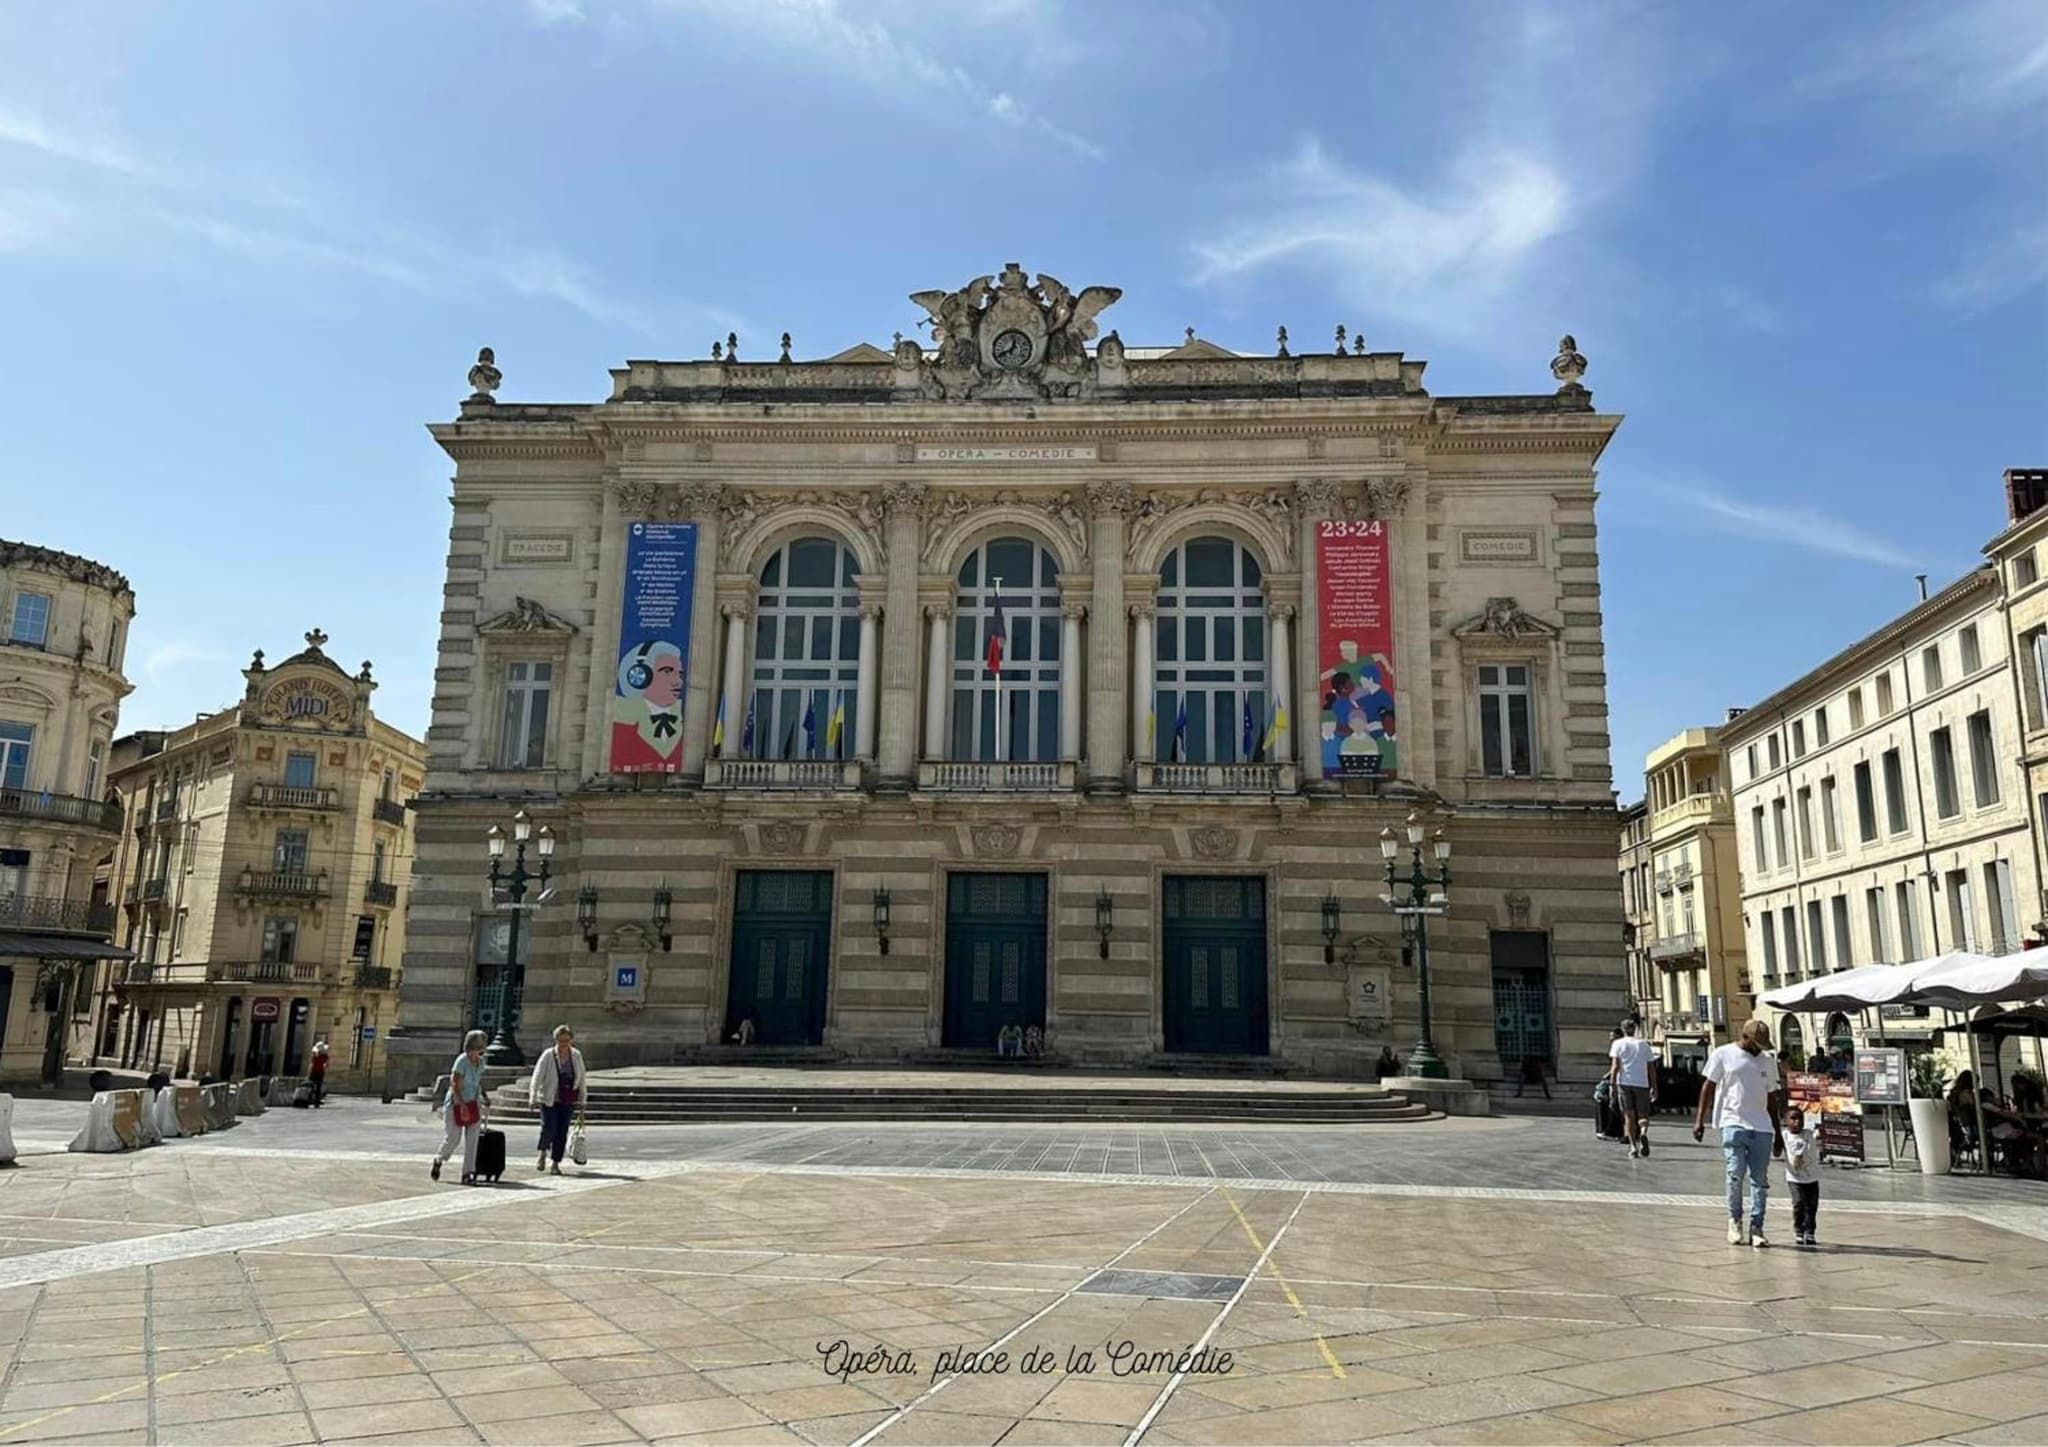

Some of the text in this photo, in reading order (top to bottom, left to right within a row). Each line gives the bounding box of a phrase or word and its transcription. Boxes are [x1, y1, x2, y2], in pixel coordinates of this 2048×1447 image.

[269, 679, 308, 705] GRAND
[286, 696, 329, 716] MIDI
[621, 973, 633, 984] M
